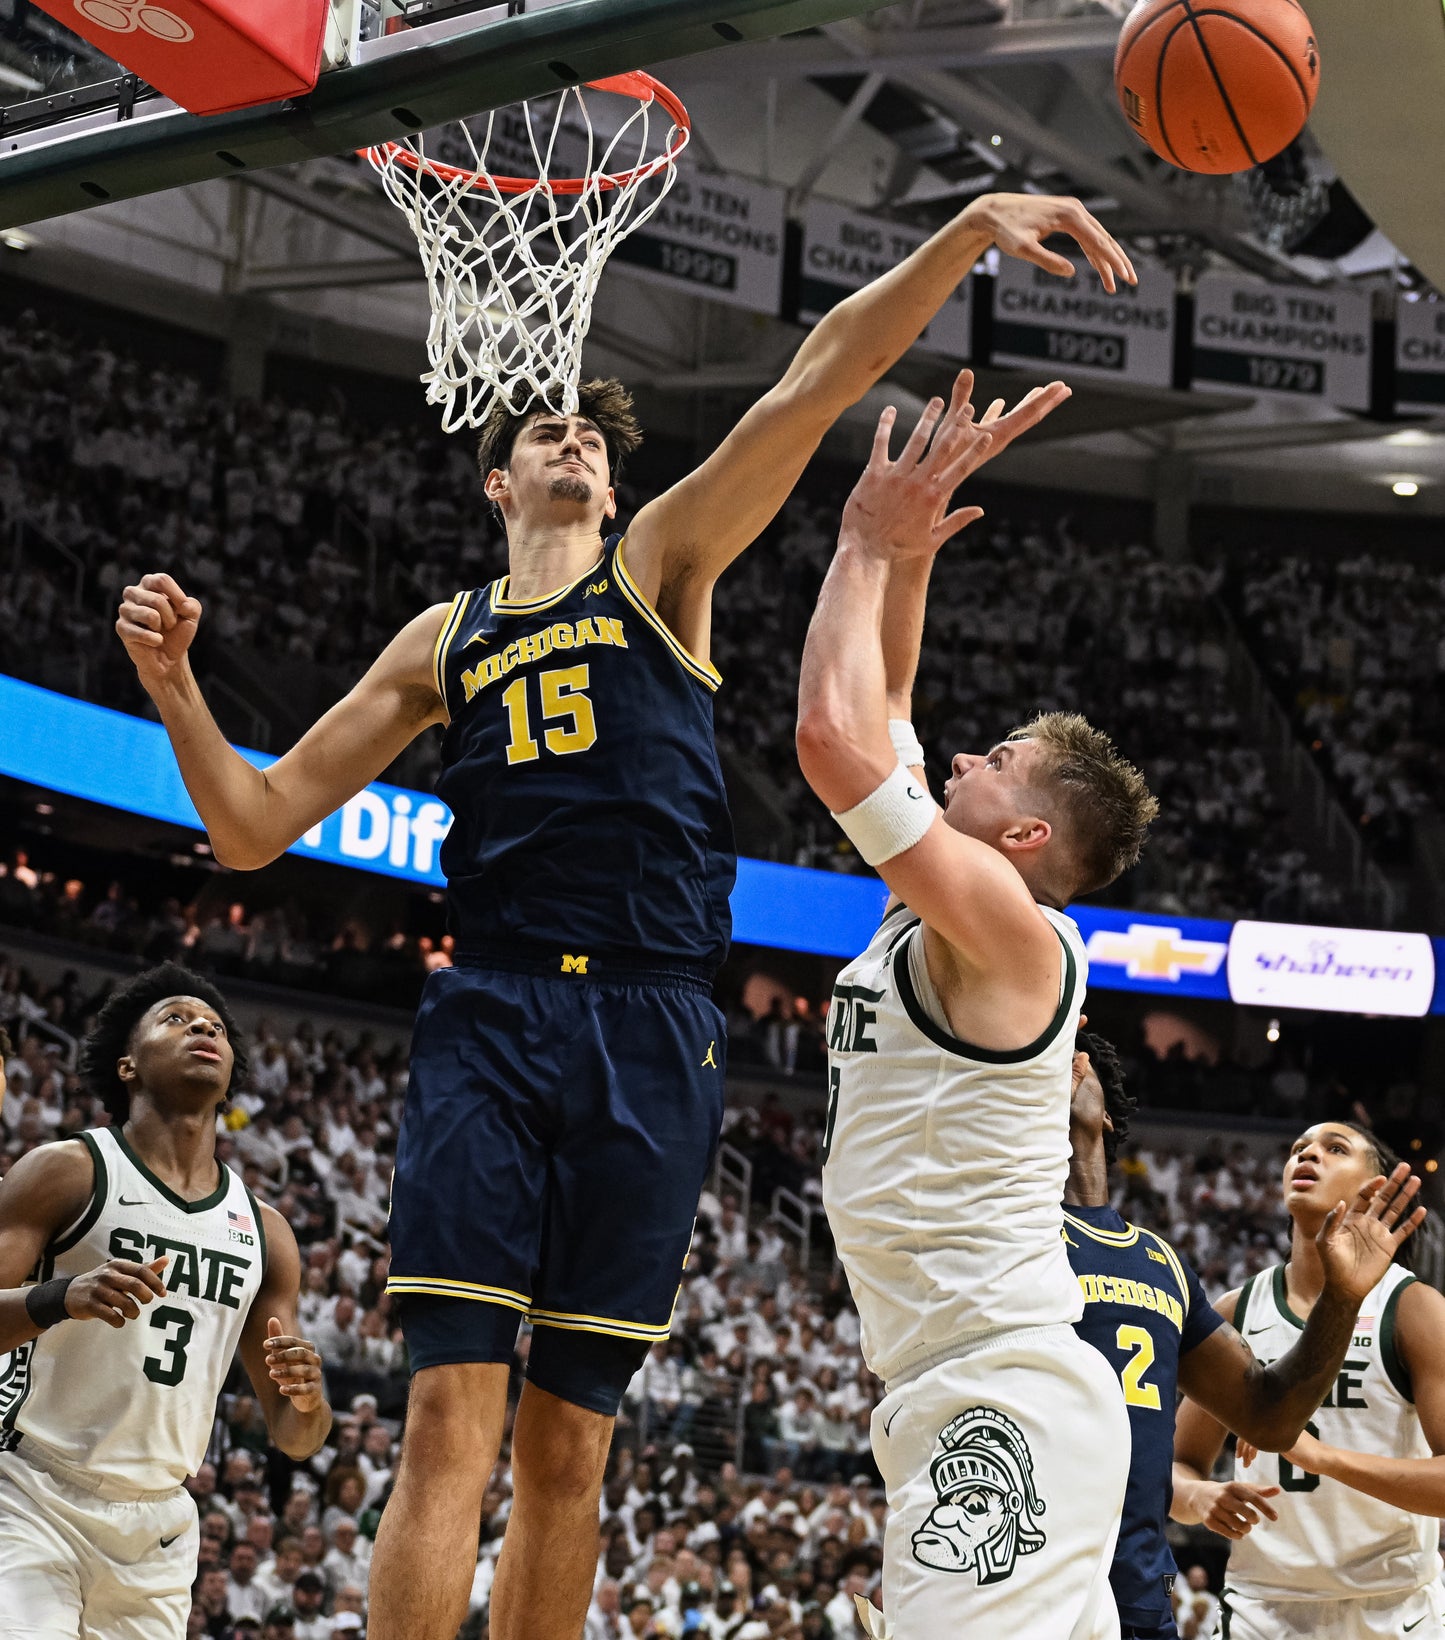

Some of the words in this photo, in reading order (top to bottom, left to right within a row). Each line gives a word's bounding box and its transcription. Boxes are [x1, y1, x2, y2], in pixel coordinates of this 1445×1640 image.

[700, 186, 751, 220] TEN
[840, 220, 882, 254] BIG
[661, 242, 731, 286] 1999
[1001, 286, 1169, 331] CHAMPIONS
[1233, 290, 1277, 317] BIG
[1285, 297, 1337, 324] TEN
[1048, 330, 1122, 368] 1990
[1200, 313, 1366, 357] CHAMPIONS
[1249, 357, 1317, 391] 1979
[460, 616, 629, 703] MICHIGAN
[502, 663, 598, 766] 15
[339, 789, 455, 873] Dif
[560, 953, 589, 975] M
[108, 1227, 253, 1310] STATE
[143, 1304, 195, 1387] 3
[1116, 1323, 1162, 1411] 2
